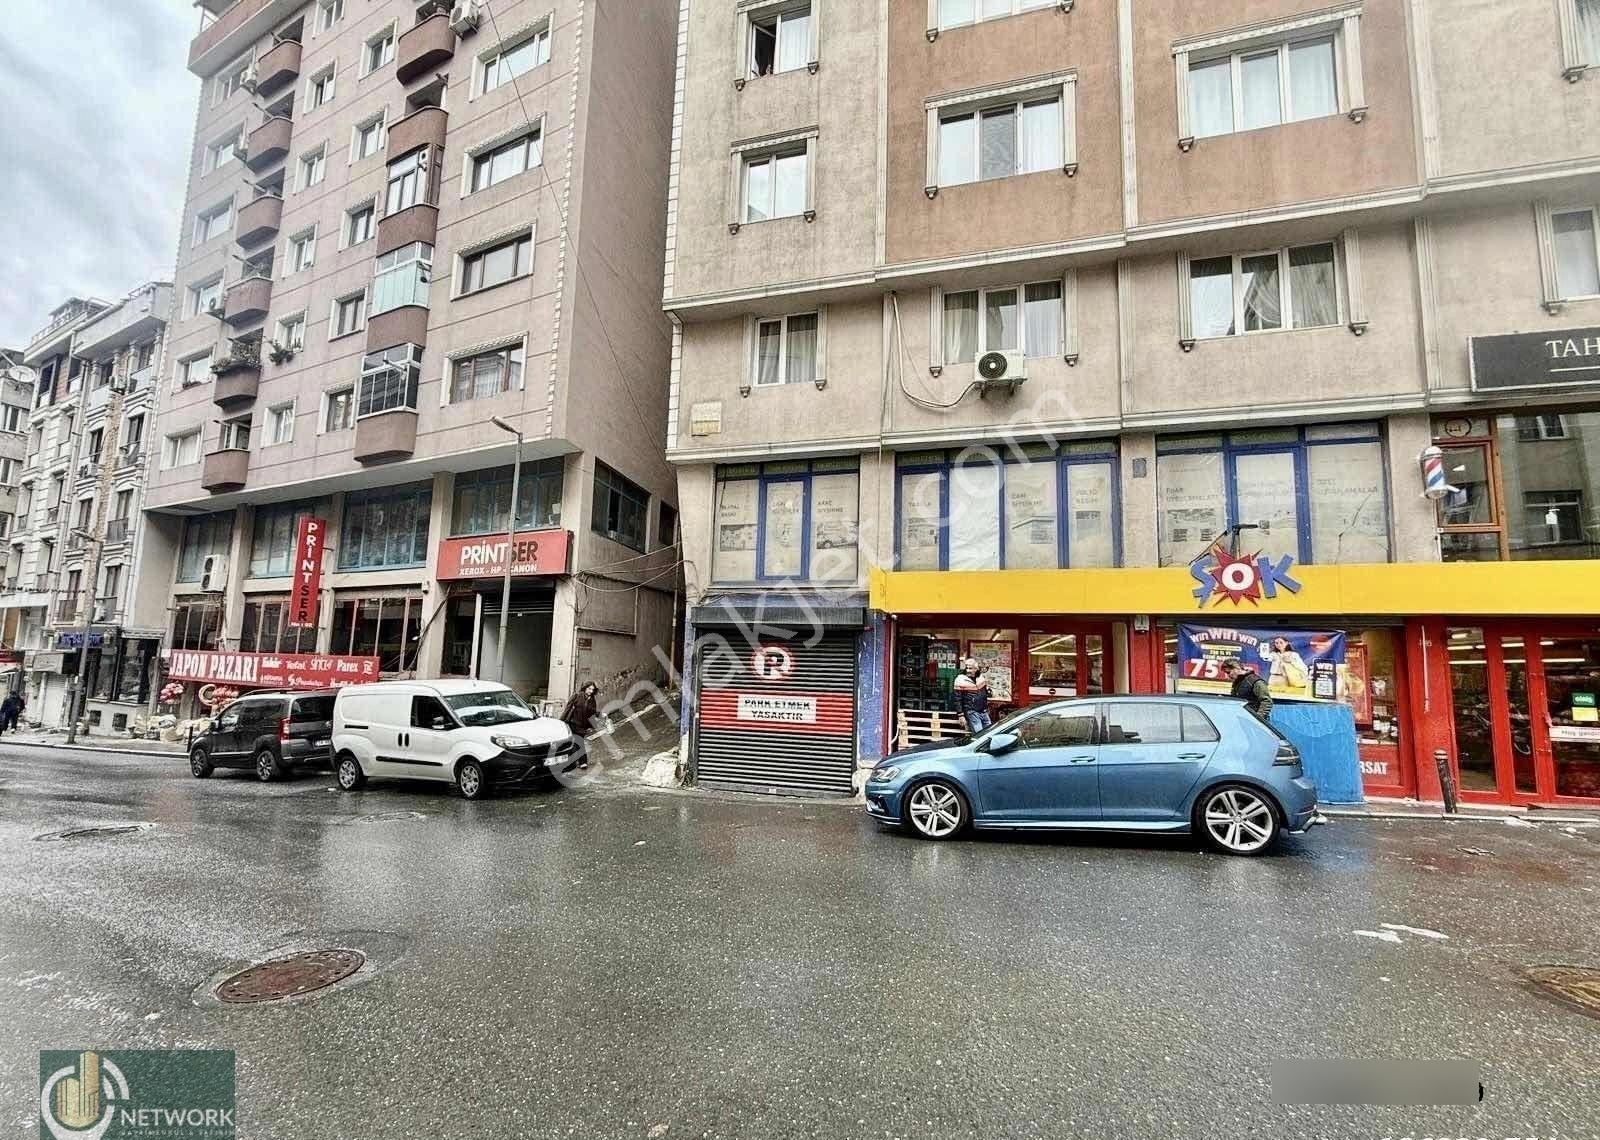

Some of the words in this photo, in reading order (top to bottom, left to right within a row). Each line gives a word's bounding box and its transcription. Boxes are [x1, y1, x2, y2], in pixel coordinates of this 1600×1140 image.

[1545, 337, 1600, 358] TAH
[458, 566, 485, 576] XEROX
[491, 566, 502, 575] HP
[169, 653, 205, 678] JAPON
[211, 654, 259, 682] PAZARI
[336, 658, 359, 672] Parex
[744, 699, 771, 709] PARK
[752, 710, 804, 721] YASAKTIR
